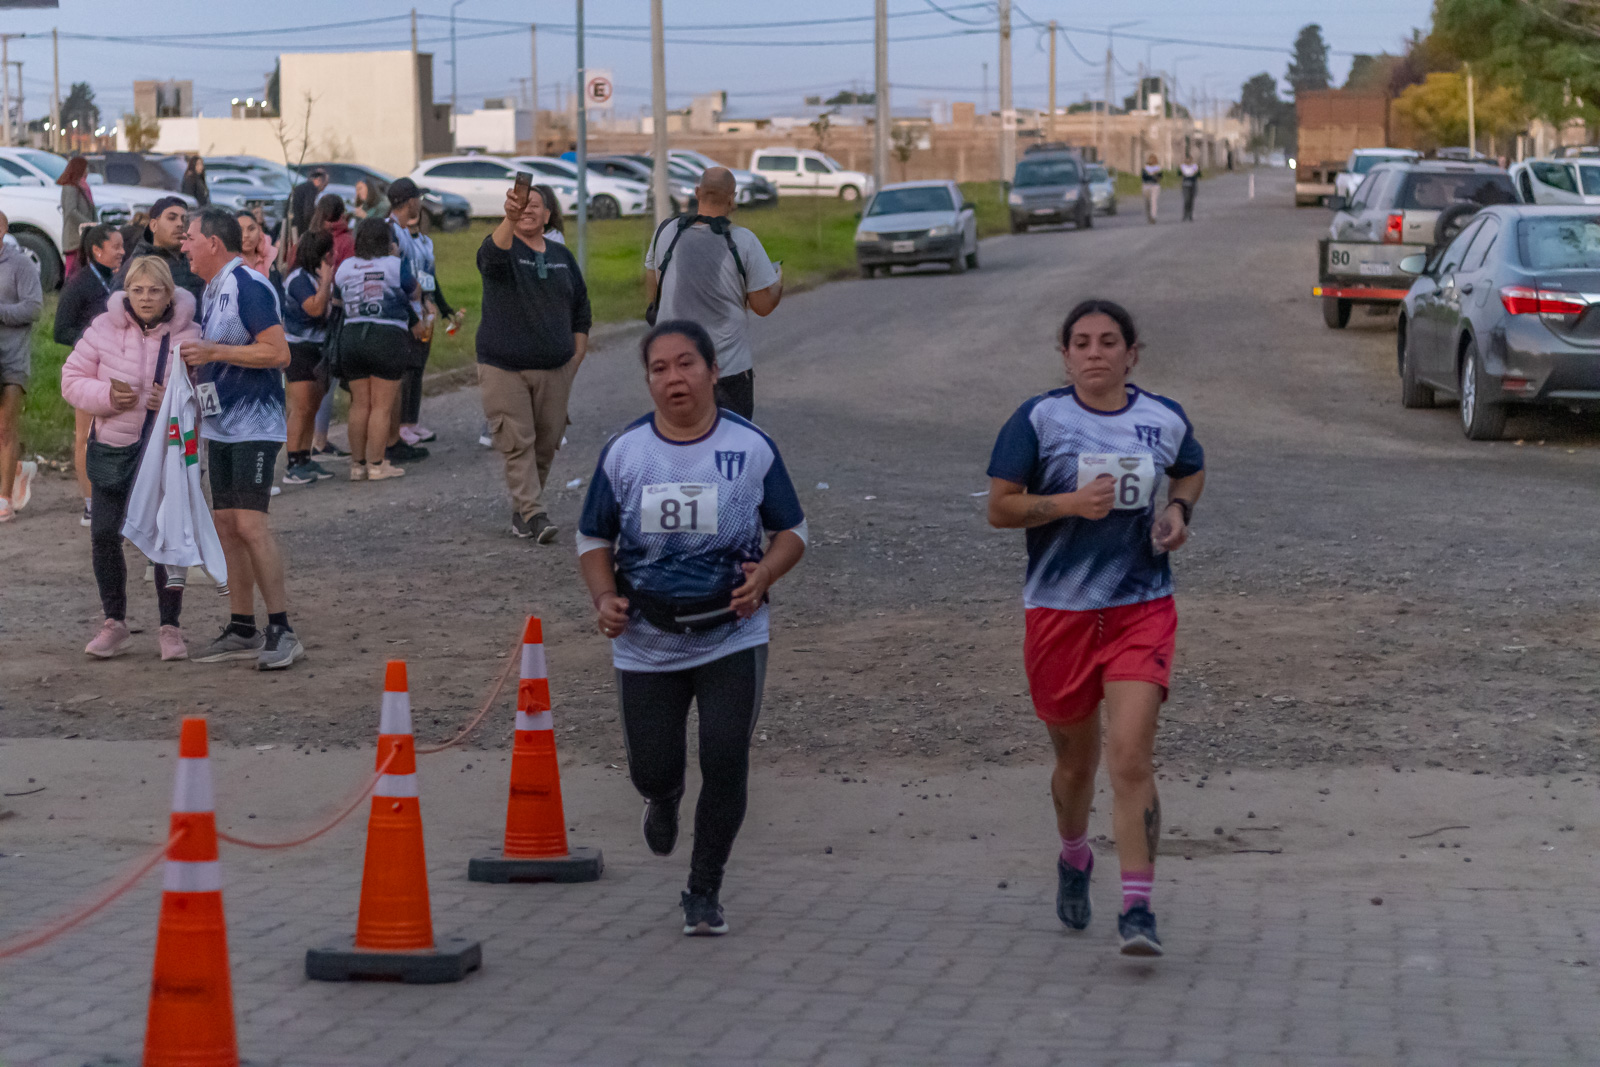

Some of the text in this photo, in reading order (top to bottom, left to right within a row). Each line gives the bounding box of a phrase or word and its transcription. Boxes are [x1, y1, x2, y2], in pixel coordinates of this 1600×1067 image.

[594, 82, 605, 97] E
[1331, 250, 1350, 265] 80
[1096, 473, 1140, 505] 6
[660, 498, 699, 530] 81
